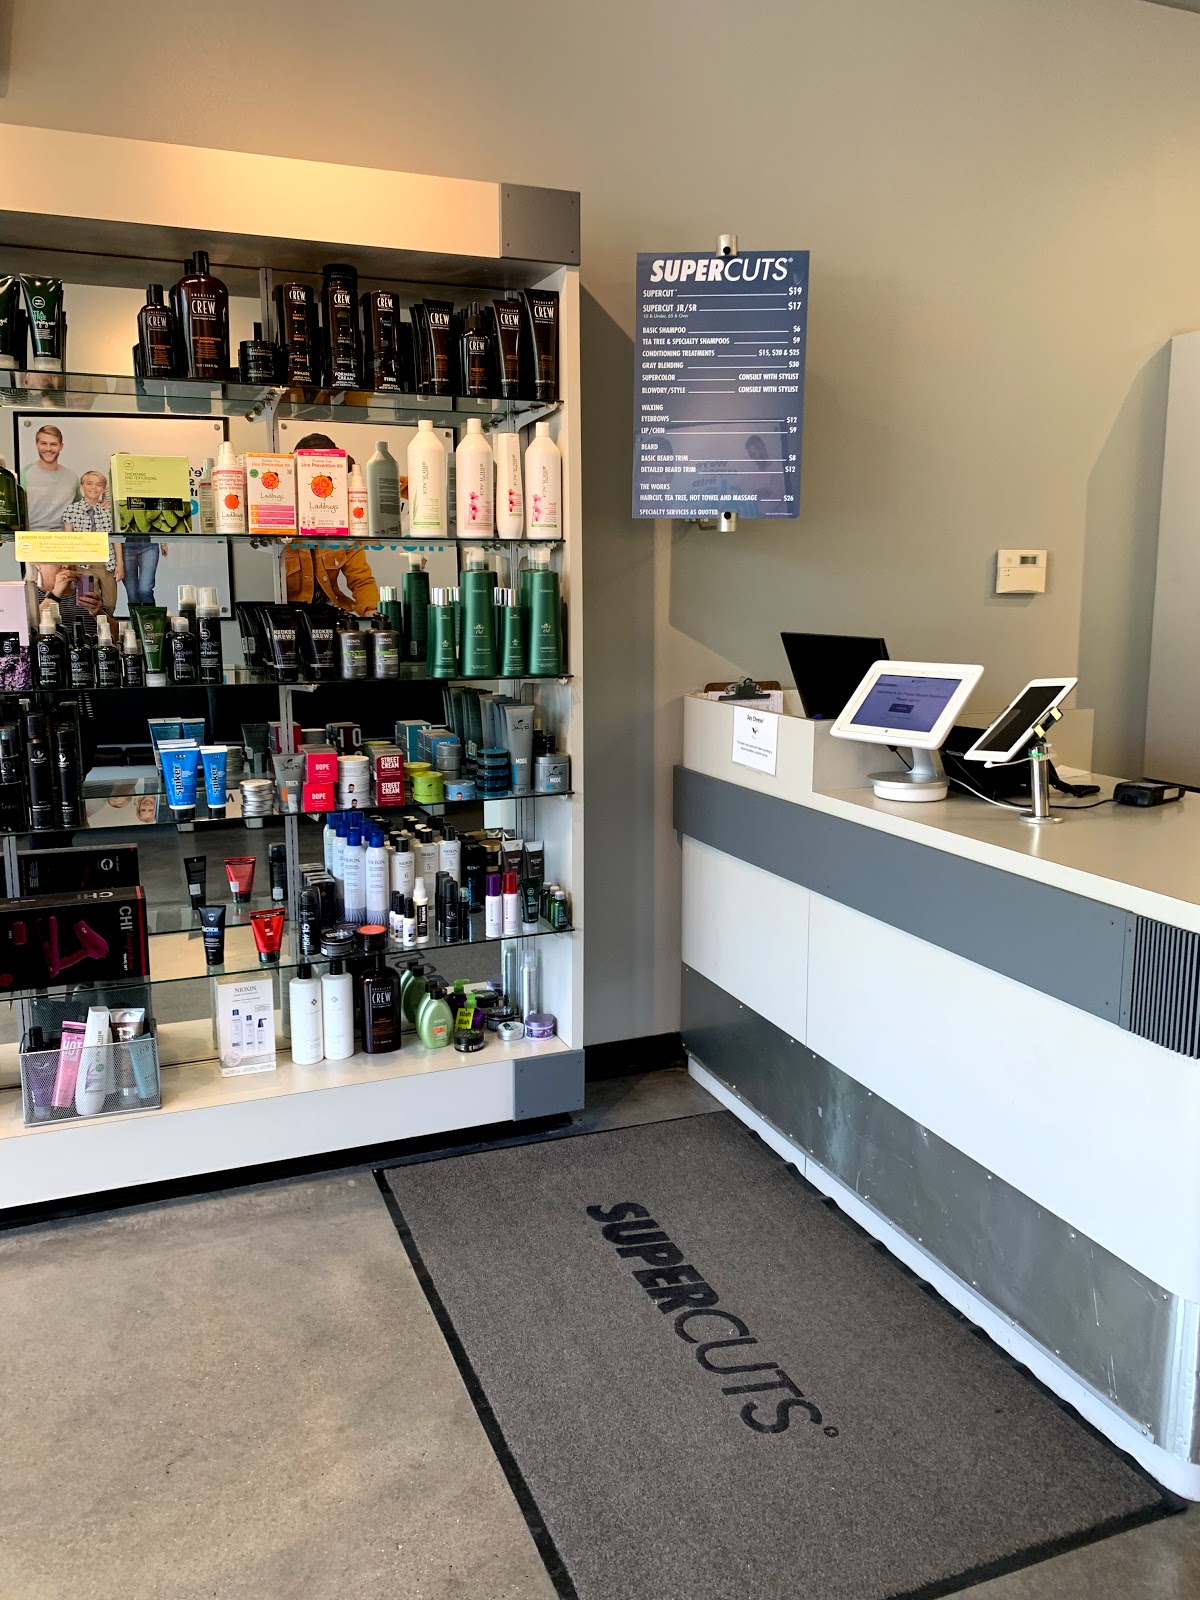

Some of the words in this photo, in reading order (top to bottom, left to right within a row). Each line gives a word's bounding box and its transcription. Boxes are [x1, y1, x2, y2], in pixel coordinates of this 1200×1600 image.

[289, 290, 306, 301] CREW
[643, 289, 674, 298] SUPERCUT
[788, 286, 802, 296] $19
[334, 293, 351, 304] CREW
[377, 297, 393, 309] CREW
[191, 300, 216, 315] CREW
[534, 305, 554, 319] CREW
[643, 304, 674, 313] SUPERCUT
[676, 303, 697, 313] JR/SR
[787, 302, 802, 311] $17
[149, 316, 167, 327] CREW
[430, 312, 450, 325] CREW
[500, 313, 520, 326] CREW
[658, 326, 687, 334] SHAMPOO
[793, 325, 801, 333] $6
[469, 340, 485, 351] CREW
[792, 336, 801, 344] $9
[758, 349, 771, 357] $15,
[738, 373, 762, 381] CONSULT
[641, 386, 686, 395] BLOWDRY/STYLE
[641, 415, 670, 423] EYEBROWS
[786, 416, 798, 424] $12
[641, 427, 666, 435] LIP/CHIN
[789, 426, 797, 434] $9
[788, 454, 797, 462] $8
[260, 493, 284, 502] Ladibugs
[639, 494, 664, 502] HAIRCUT,
[674, 494, 689, 502] TREE,
[309, 502, 339, 514] Ladibugs
[689, 508, 697, 516] AS
[697, 508, 719, 516] QUOTED
[380, 756, 400, 764] STREET
[315, 763, 330, 771] DOPE
[174, 766, 184, 796] spiker
[212, 766, 220, 794] spiker
[382, 787, 400, 795] CREAM
[119, 906, 133, 930] CHI
[234, 985, 257, 994] NIOXIN
[372, 992, 392, 1004] CREW
[586, 1202, 822, 1434] SUPERCUTS
